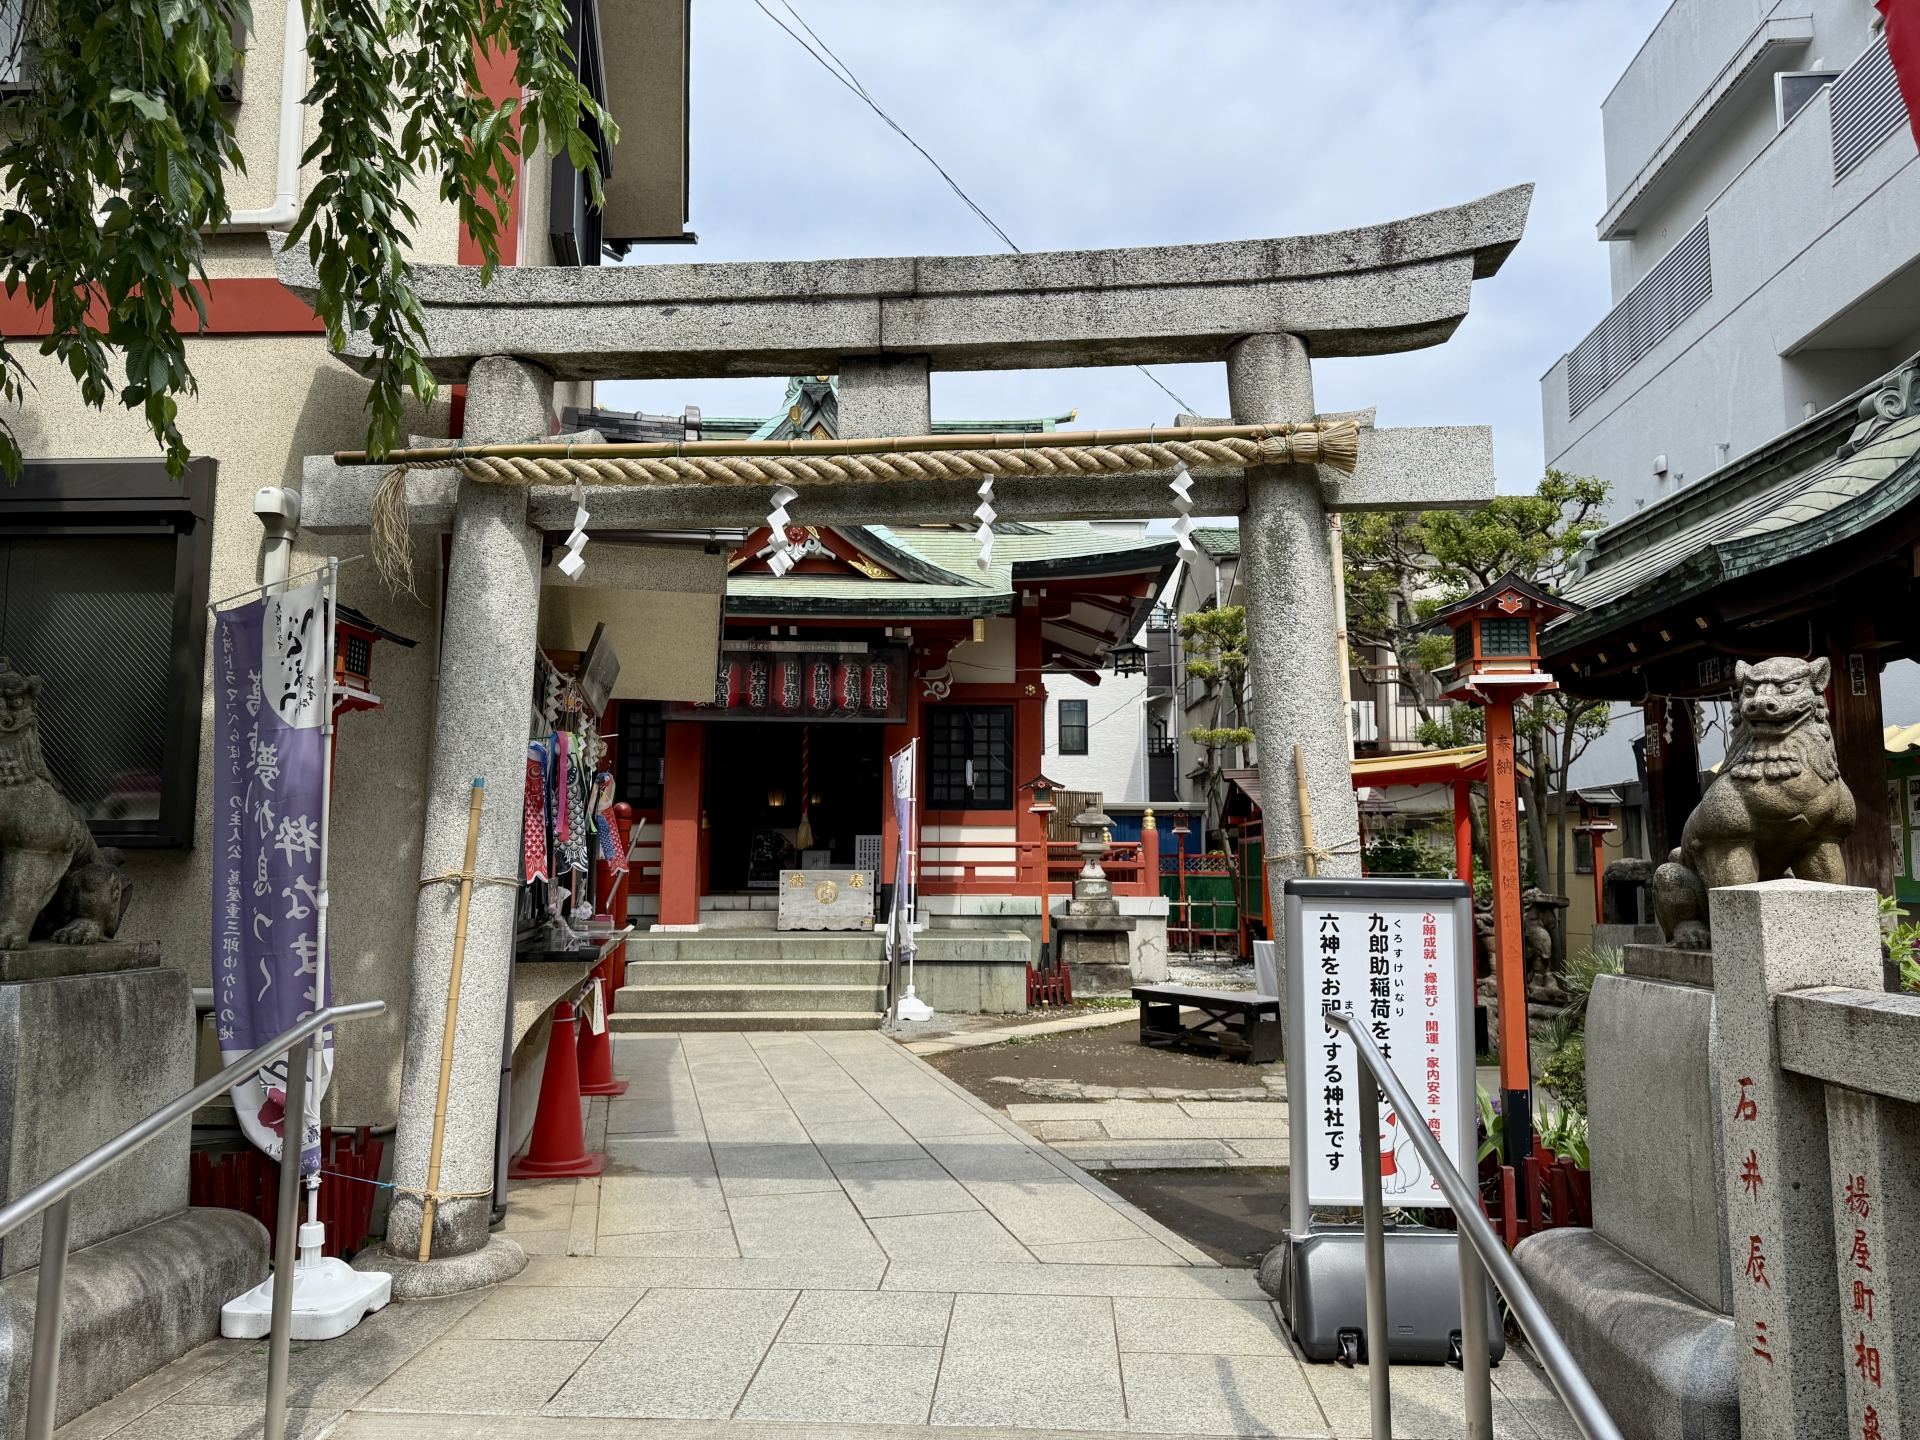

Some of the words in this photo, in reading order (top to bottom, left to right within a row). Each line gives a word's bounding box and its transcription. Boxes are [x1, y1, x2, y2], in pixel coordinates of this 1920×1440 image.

[813, 662, 832, 710] 九郎助稲荷
[870, 662, 888, 710] 吉原神社
[1495, 734, 1512, 775] 奉納
[789, 873, 805, 889] 納
[849, 873, 865, 889] 奉
[1393, 919, 1405, 1018] くろすけいなり
[1367, 912, 1392, 1104] 九郎助稲荷をはめ
[1319, 912, 1345, 1171] 六神をお祀りする神社です
[1733, 1077, 1774, 1365] 石井辰三
